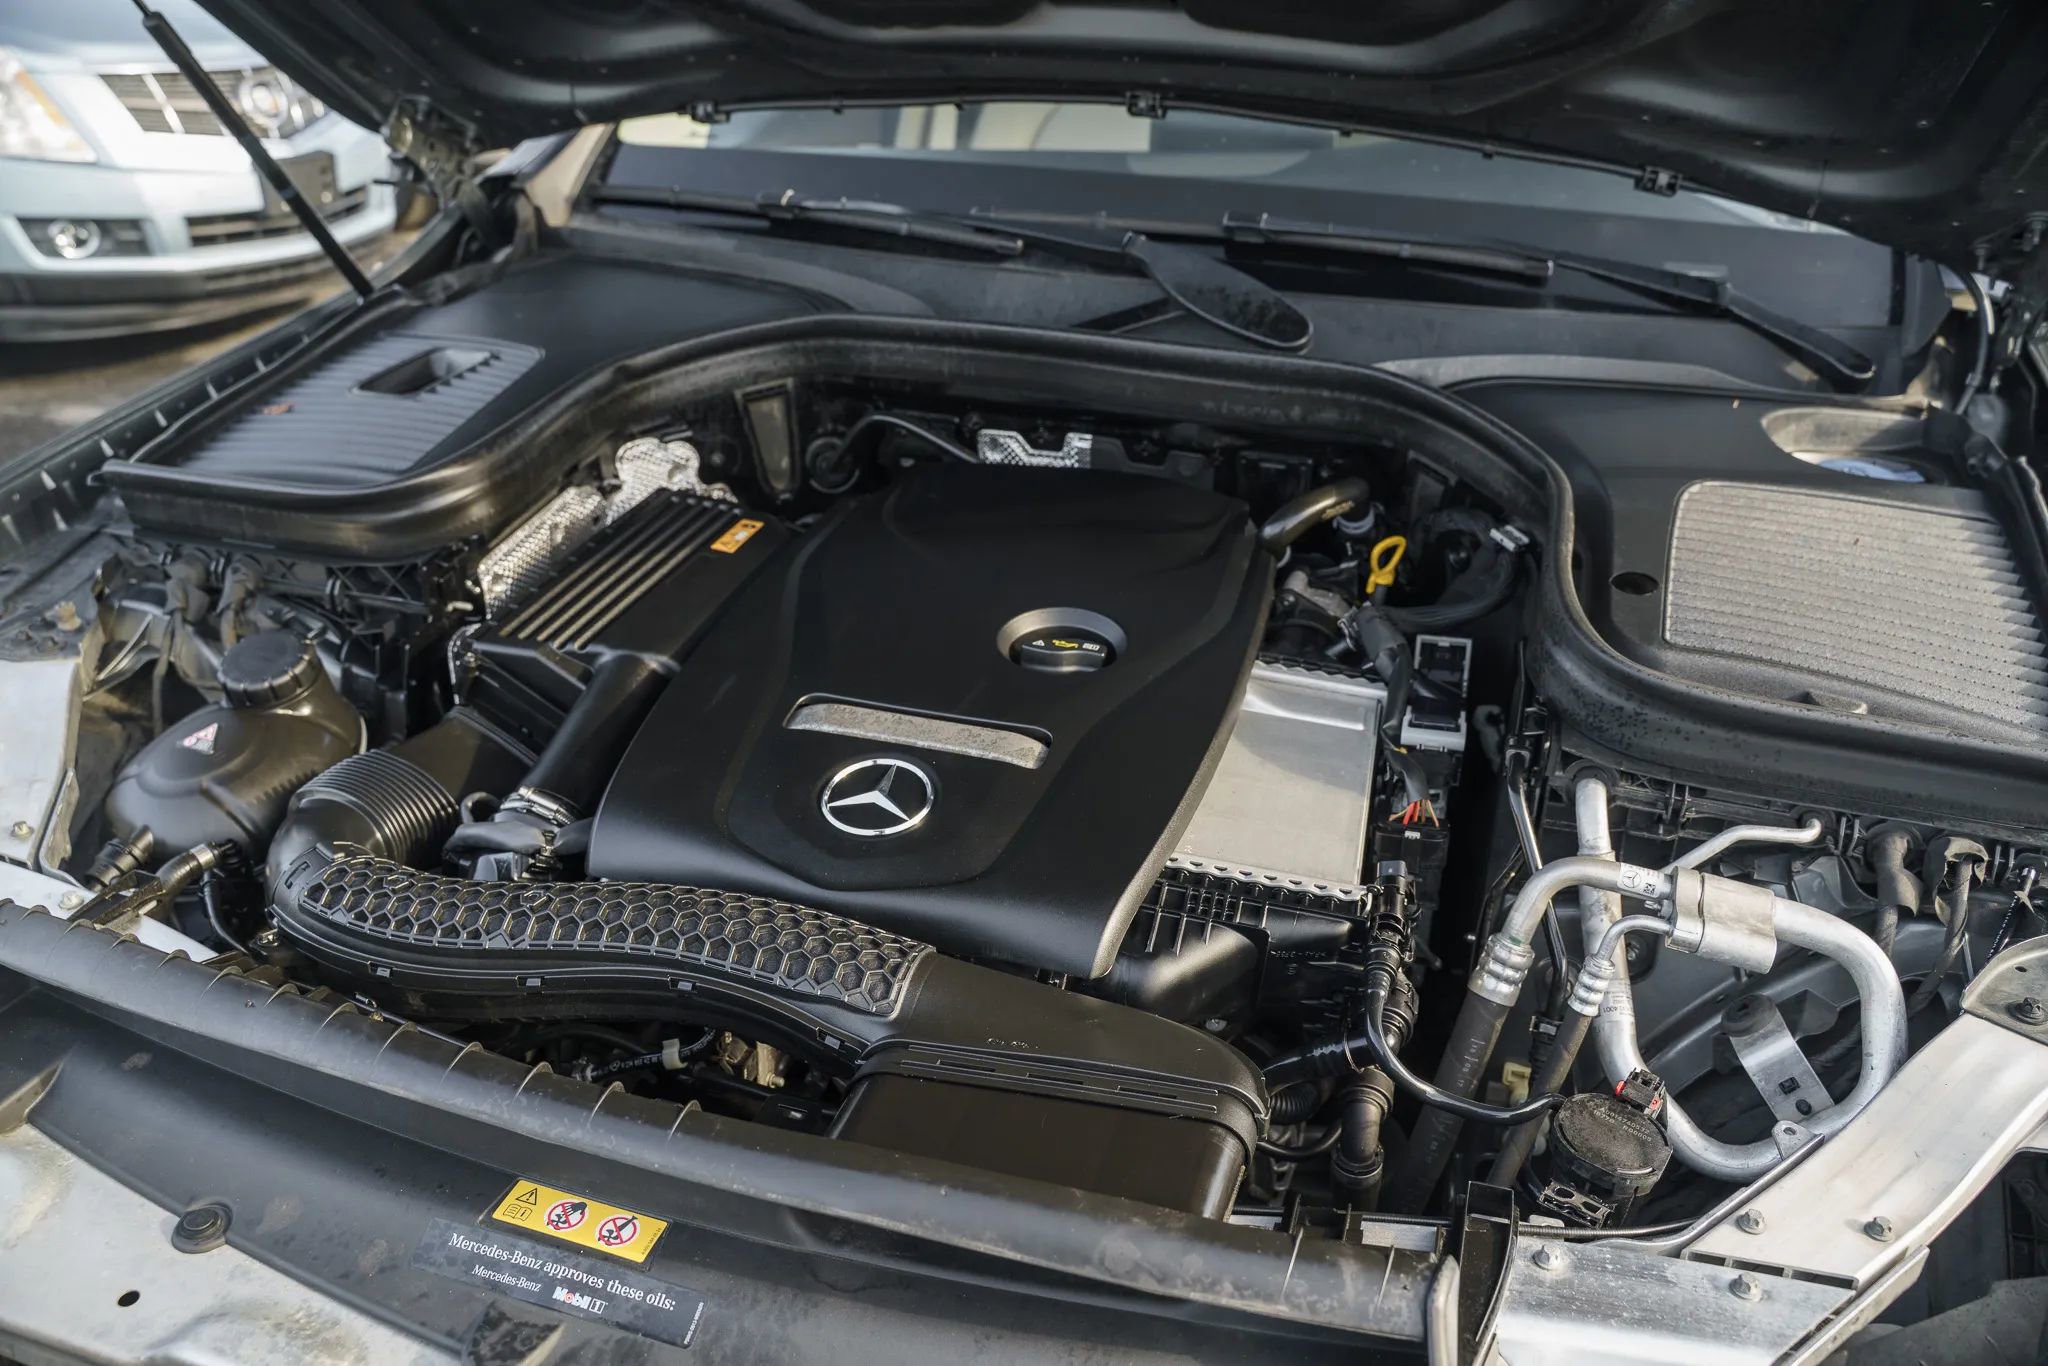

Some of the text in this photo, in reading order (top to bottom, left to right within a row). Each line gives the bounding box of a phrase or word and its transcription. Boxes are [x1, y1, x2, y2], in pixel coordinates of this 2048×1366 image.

[448, 1232, 676, 1311] Mercedes-Benz approves these oils:
[472, 1264, 542, 1292] Mercedes-Benz
[552, 1286, 591, 1310] Mobil
